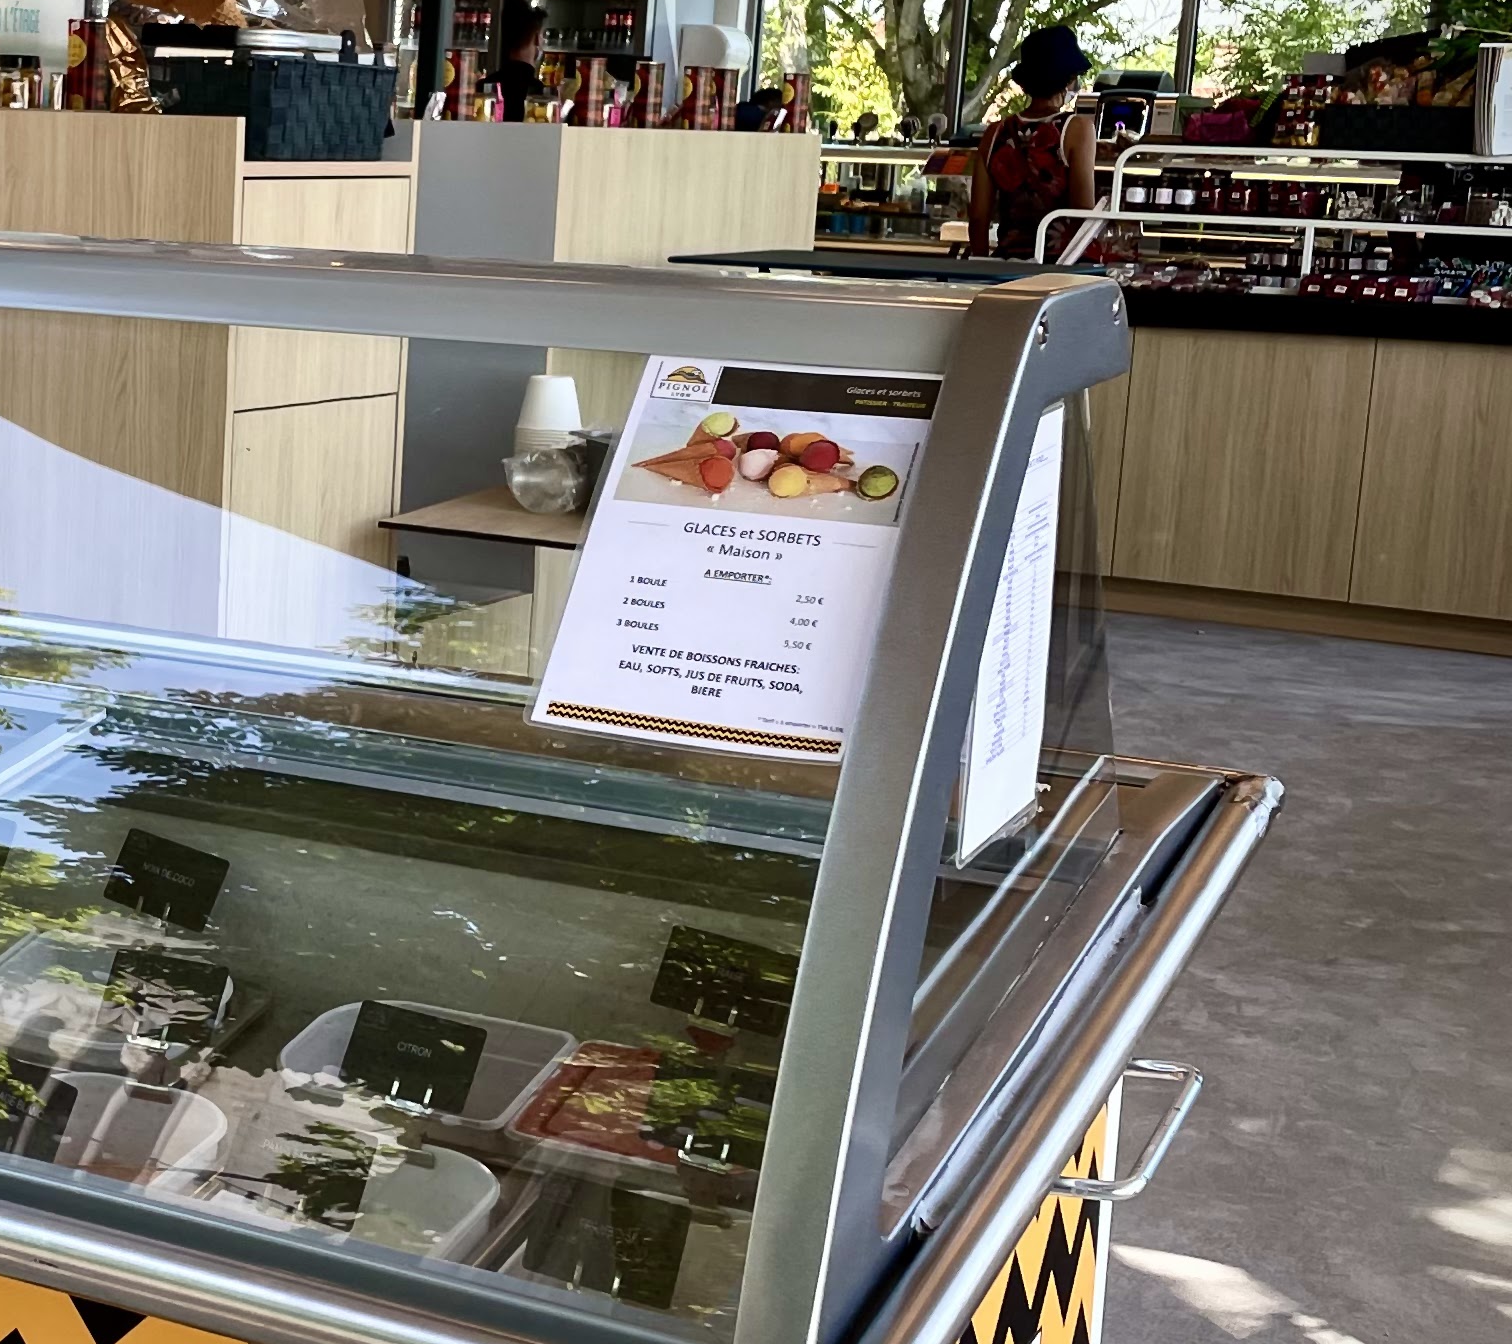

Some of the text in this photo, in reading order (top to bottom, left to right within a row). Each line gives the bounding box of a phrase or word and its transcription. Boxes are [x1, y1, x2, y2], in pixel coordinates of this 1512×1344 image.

[658, 381, 708, 394] PIGNOL
[683, 522, 822, 547] GLACES et SORBETS
[718, 543, 770, 561] Maison
[704, 568, 711, 578] A
[638, 576, 667, 587] BOULE
[623, 597, 665, 609] 2 BOULES
[795, 594, 816, 605] 2,50
[616, 618, 659, 631] 3 BOULES
[789, 617, 810, 627] 4,00
[631, 643, 801, 675] VENTE DE BOISSONS FRAICHES:
[618, 659, 804, 695] EAU, SOFTS, JUS DE FRUITS, SODA,
[691, 684, 722, 698] BIERE
[396, 1040, 433, 1059] CITRON
